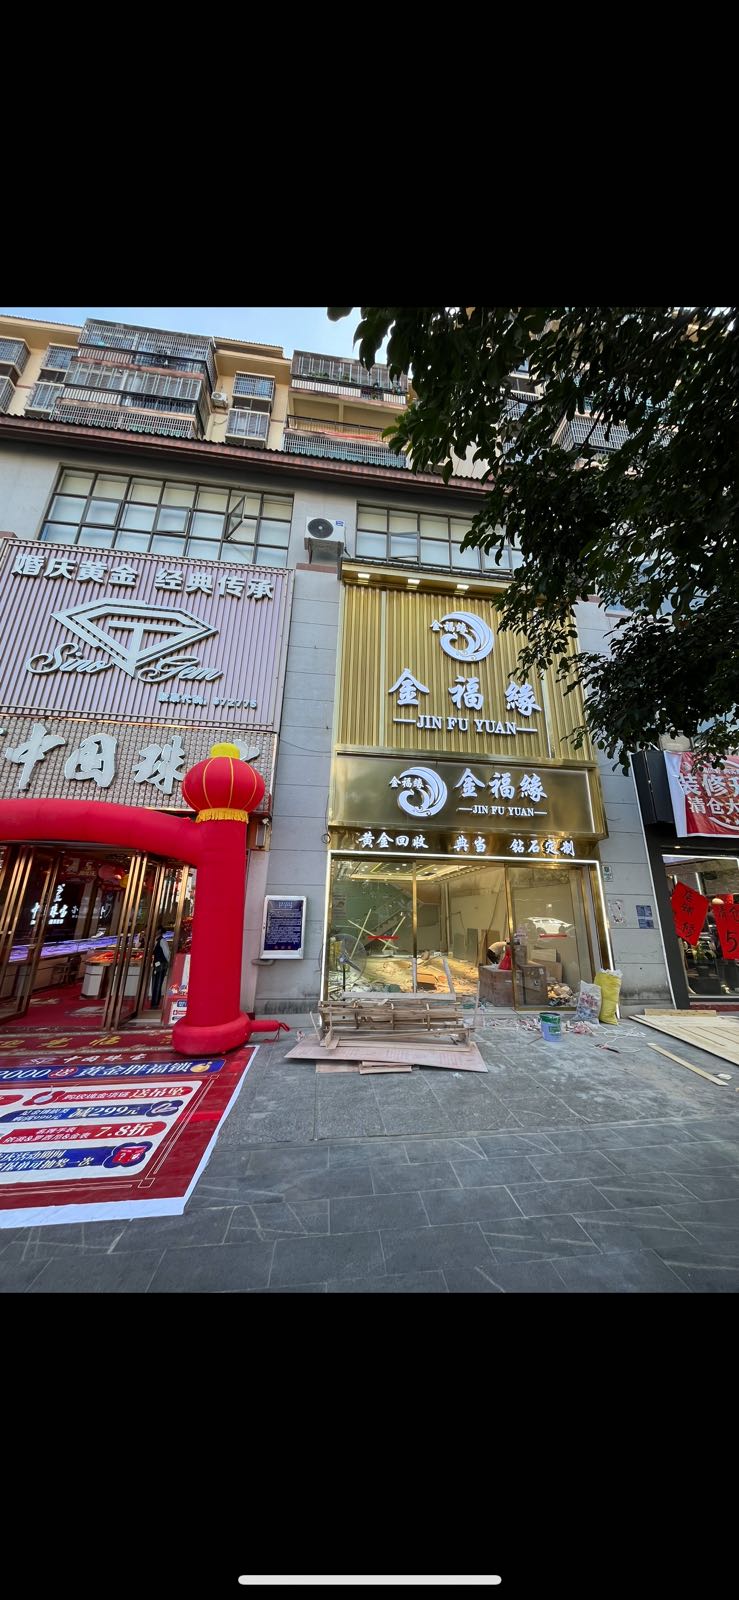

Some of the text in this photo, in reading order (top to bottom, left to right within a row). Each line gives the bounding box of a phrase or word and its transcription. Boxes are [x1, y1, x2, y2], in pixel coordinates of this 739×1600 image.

[12, 553, 275, 600] 婚庆黄金 经典传承
[27, 643, 224, 683] Sino Gem
[388, 668, 542, 717] 金福緣
[417, 715, 517, 735] JIN FU YUAN
[5, 723, 260, 795] 中国珠
[455, 768, 548, 802] 金福緣
[472, 804, 535, 818] JIN FU YUAN
[357, 831, 576, 857] 黄金回收 典当 钻石定制
[94, 1123, 153, 1137] 7.8折
